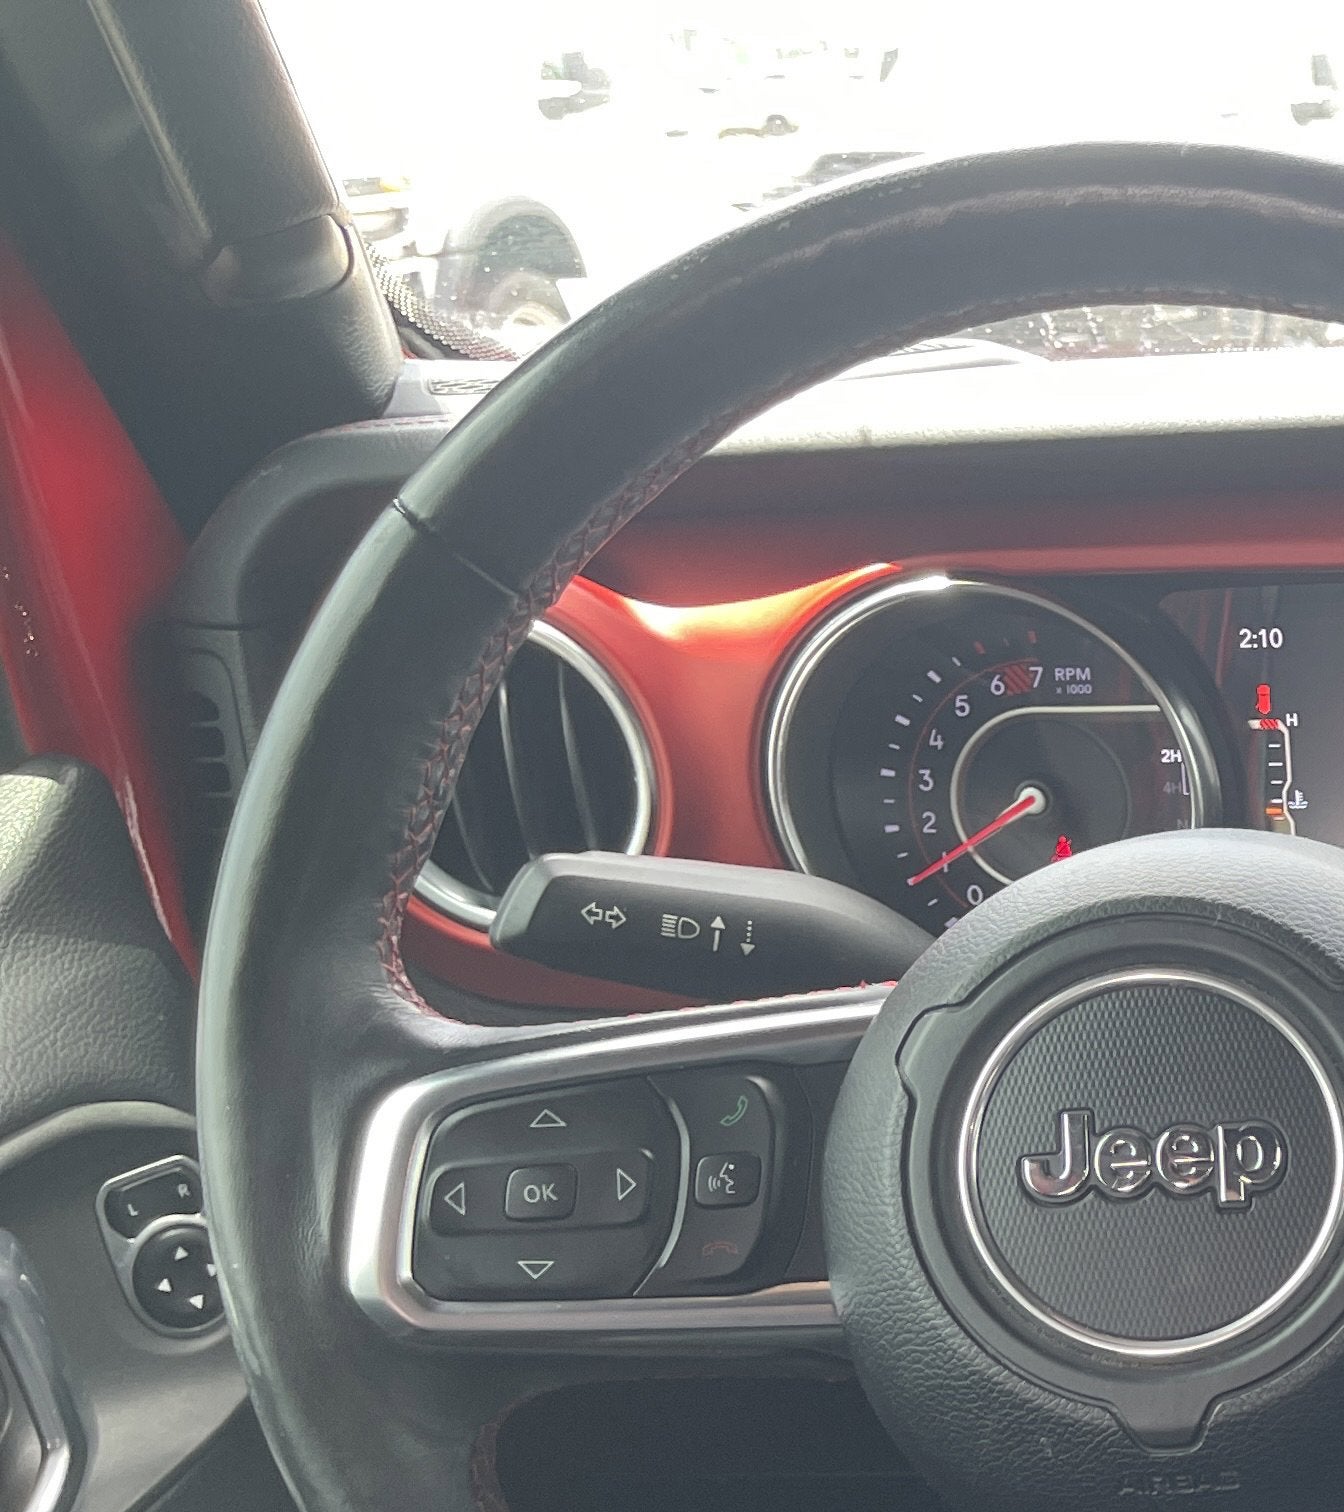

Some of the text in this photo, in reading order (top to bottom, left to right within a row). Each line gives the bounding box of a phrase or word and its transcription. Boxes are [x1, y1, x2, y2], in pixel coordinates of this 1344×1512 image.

[1239, 629, 1282, 649] 2:10
[1028, 666, 1043, 687] 7
[1054, 668, 1091, 681] RPM
[990, 675, 1005, 695] 6
[1066, 684, 1092, 694] 1000
[955, 696, 970, 717] 5
[1286, 714, 1298, 727] H
[929, 729, 944, 749] 4
[1161, 749, 1182, 762] 2H
[919, 770, 934, 791] 3
[922, 812, 937, 833] 2
[967, 885, 983, 905] 0
[1017, 1106, 1289, 1210] Jeep
[523, 1183, 557, 1203] OK
